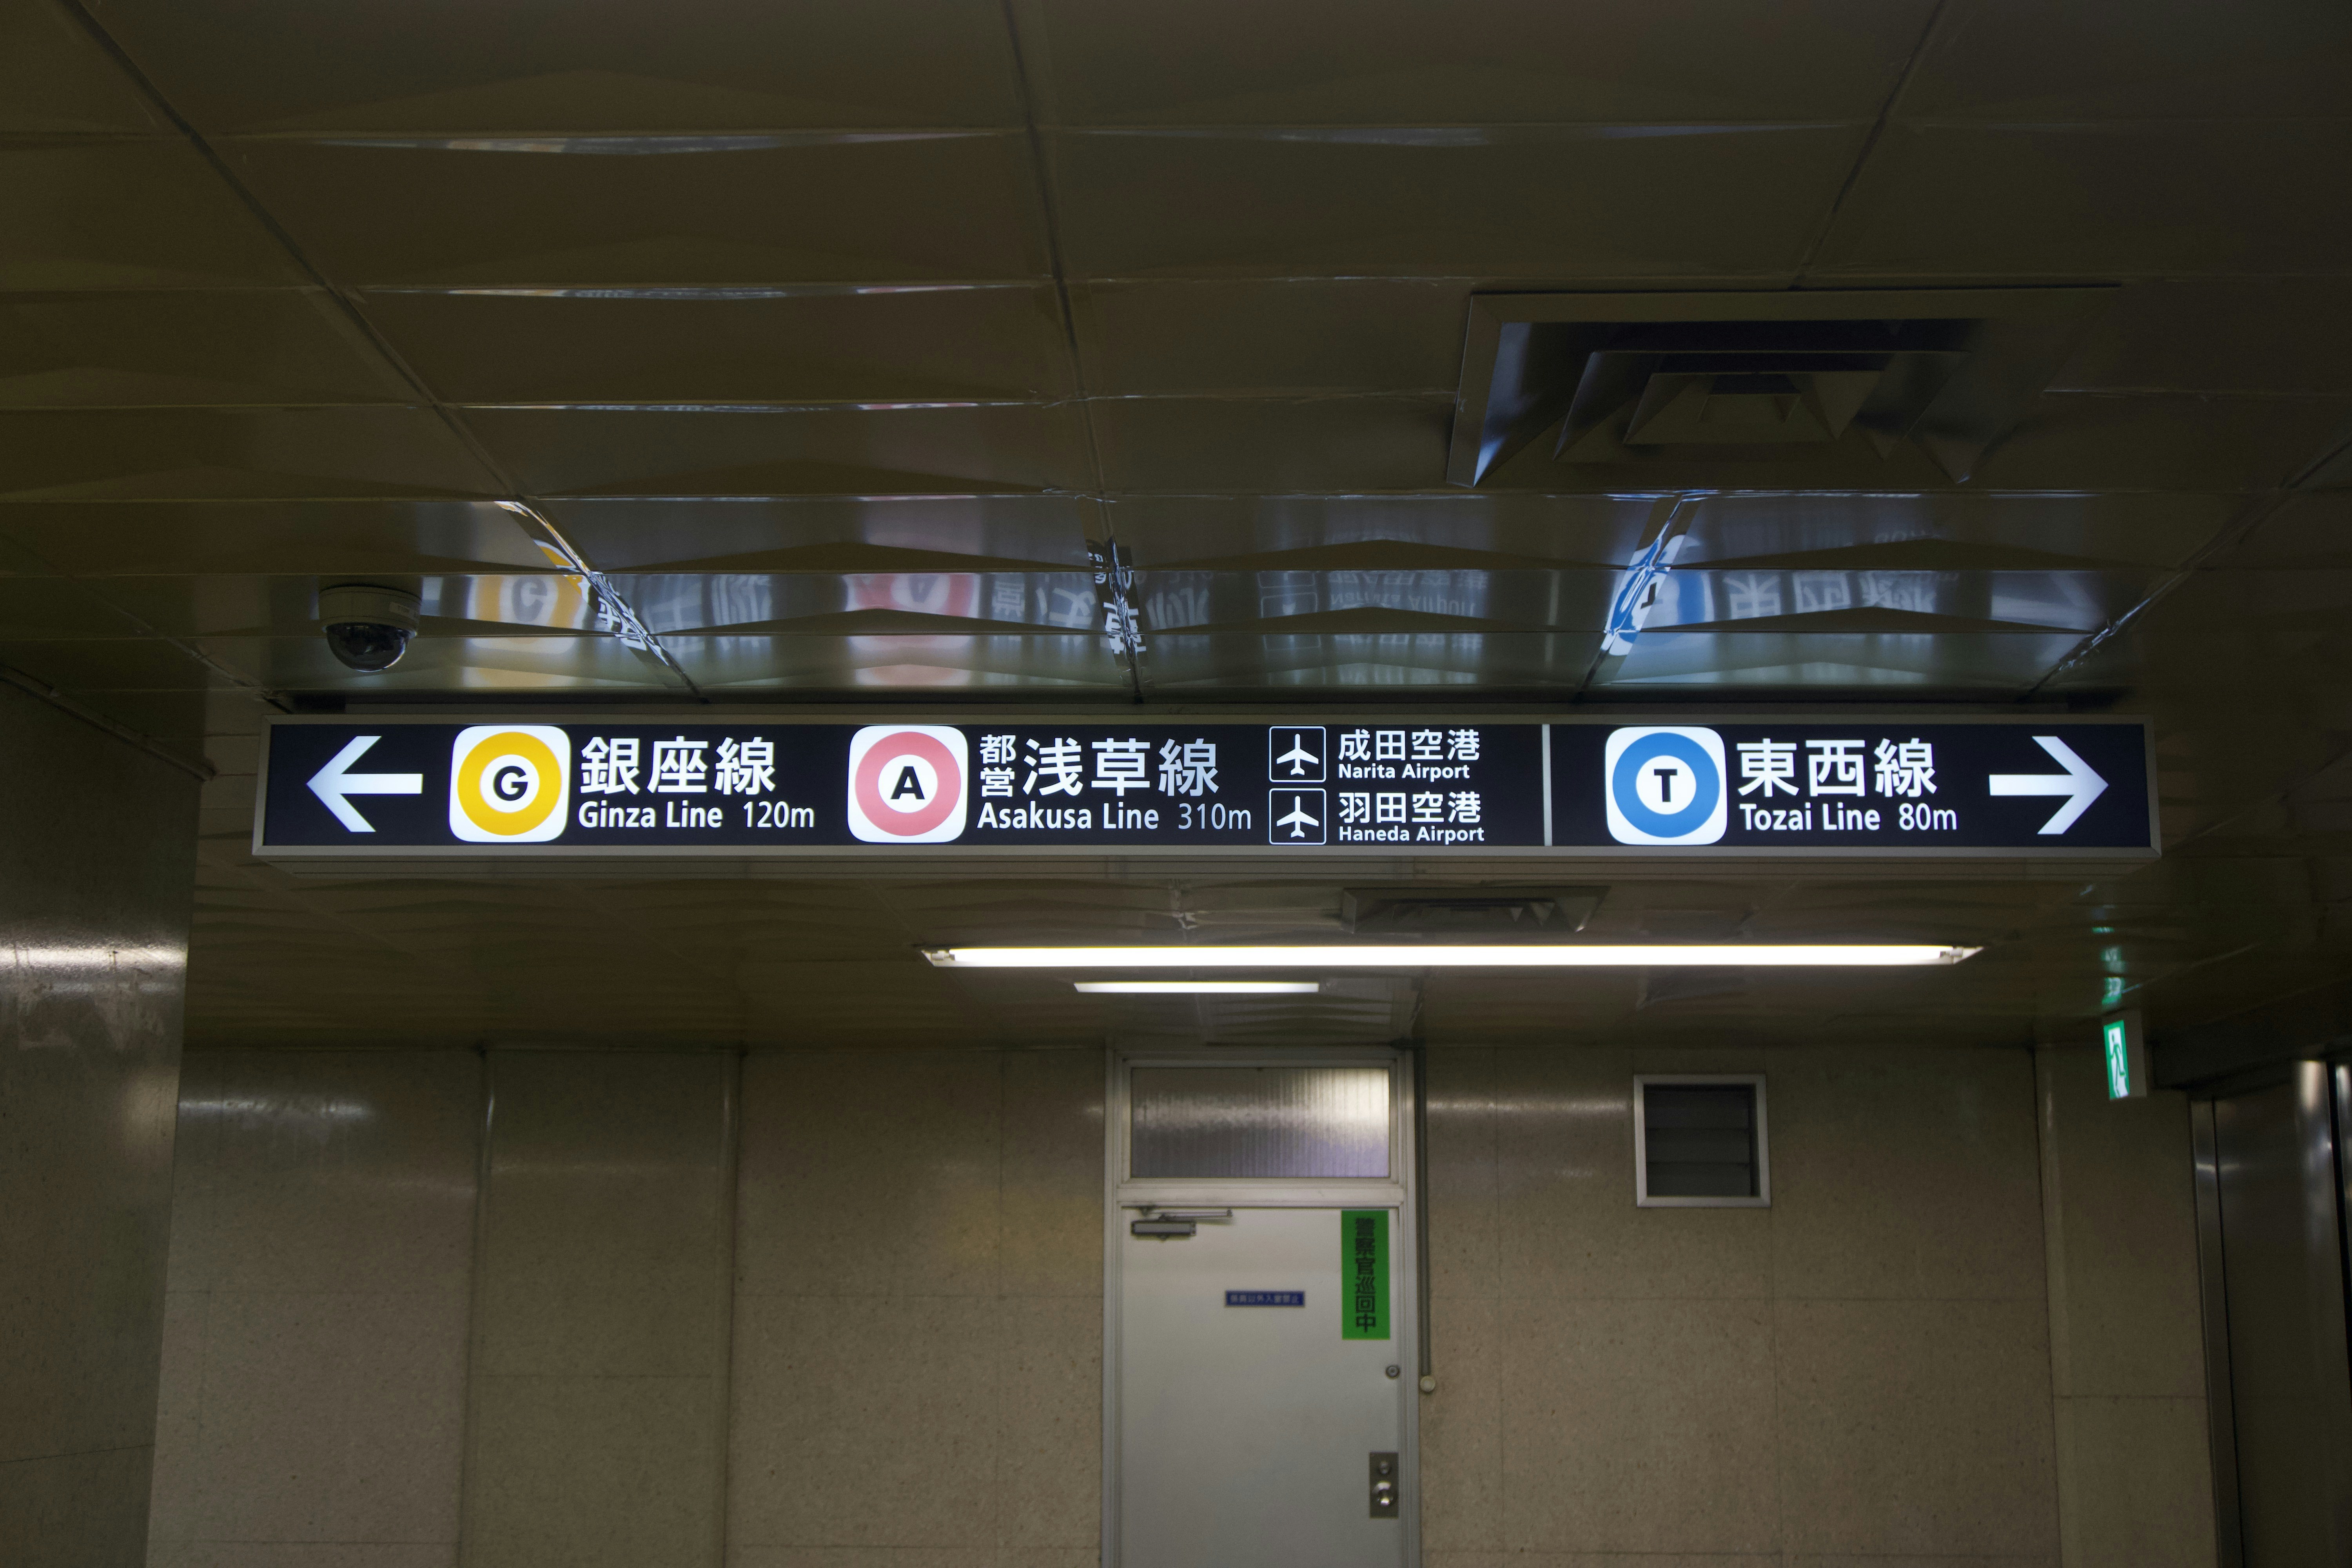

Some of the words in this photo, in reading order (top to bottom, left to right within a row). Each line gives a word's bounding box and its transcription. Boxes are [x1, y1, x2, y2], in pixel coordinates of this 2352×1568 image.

[1338, 729, 1480, 761] 成田空港
[580, 735, 776, 795] 銀座線
[1022, 737, 1220, 797] 浅草線
[1338, 763, 1396, 779] Narita
[1401, 763, 1470, 782] Airport
[1736, 737, 1937, 798] 東西線
[493, 765, 528, 802] G
[890, 766, 926, 800] A
[1653, 768, 1678, 803] T
[578, 800, 656, 828] Ginza
[666, 799, 723, 828] Line
[743, 800, 815, 828] 120m
[976, 800, 1092, 829] Asakusa
[1103, 801, 1159, 829] Line
[1178, 802, 1251, 830] 310m
[1338, 791, 1481, 824] 羽田空港
[1739, 802, 1812, 831] Tozai
[1822, 802, 1881, 831] Line
[1898, 802, 1957, 831] 80m
[1339, 825, 1410, 842] Haneda
[1416, 826, 1485, 845] Airport
[1355, 1217, 1376, 1333] 警察官巡回中
